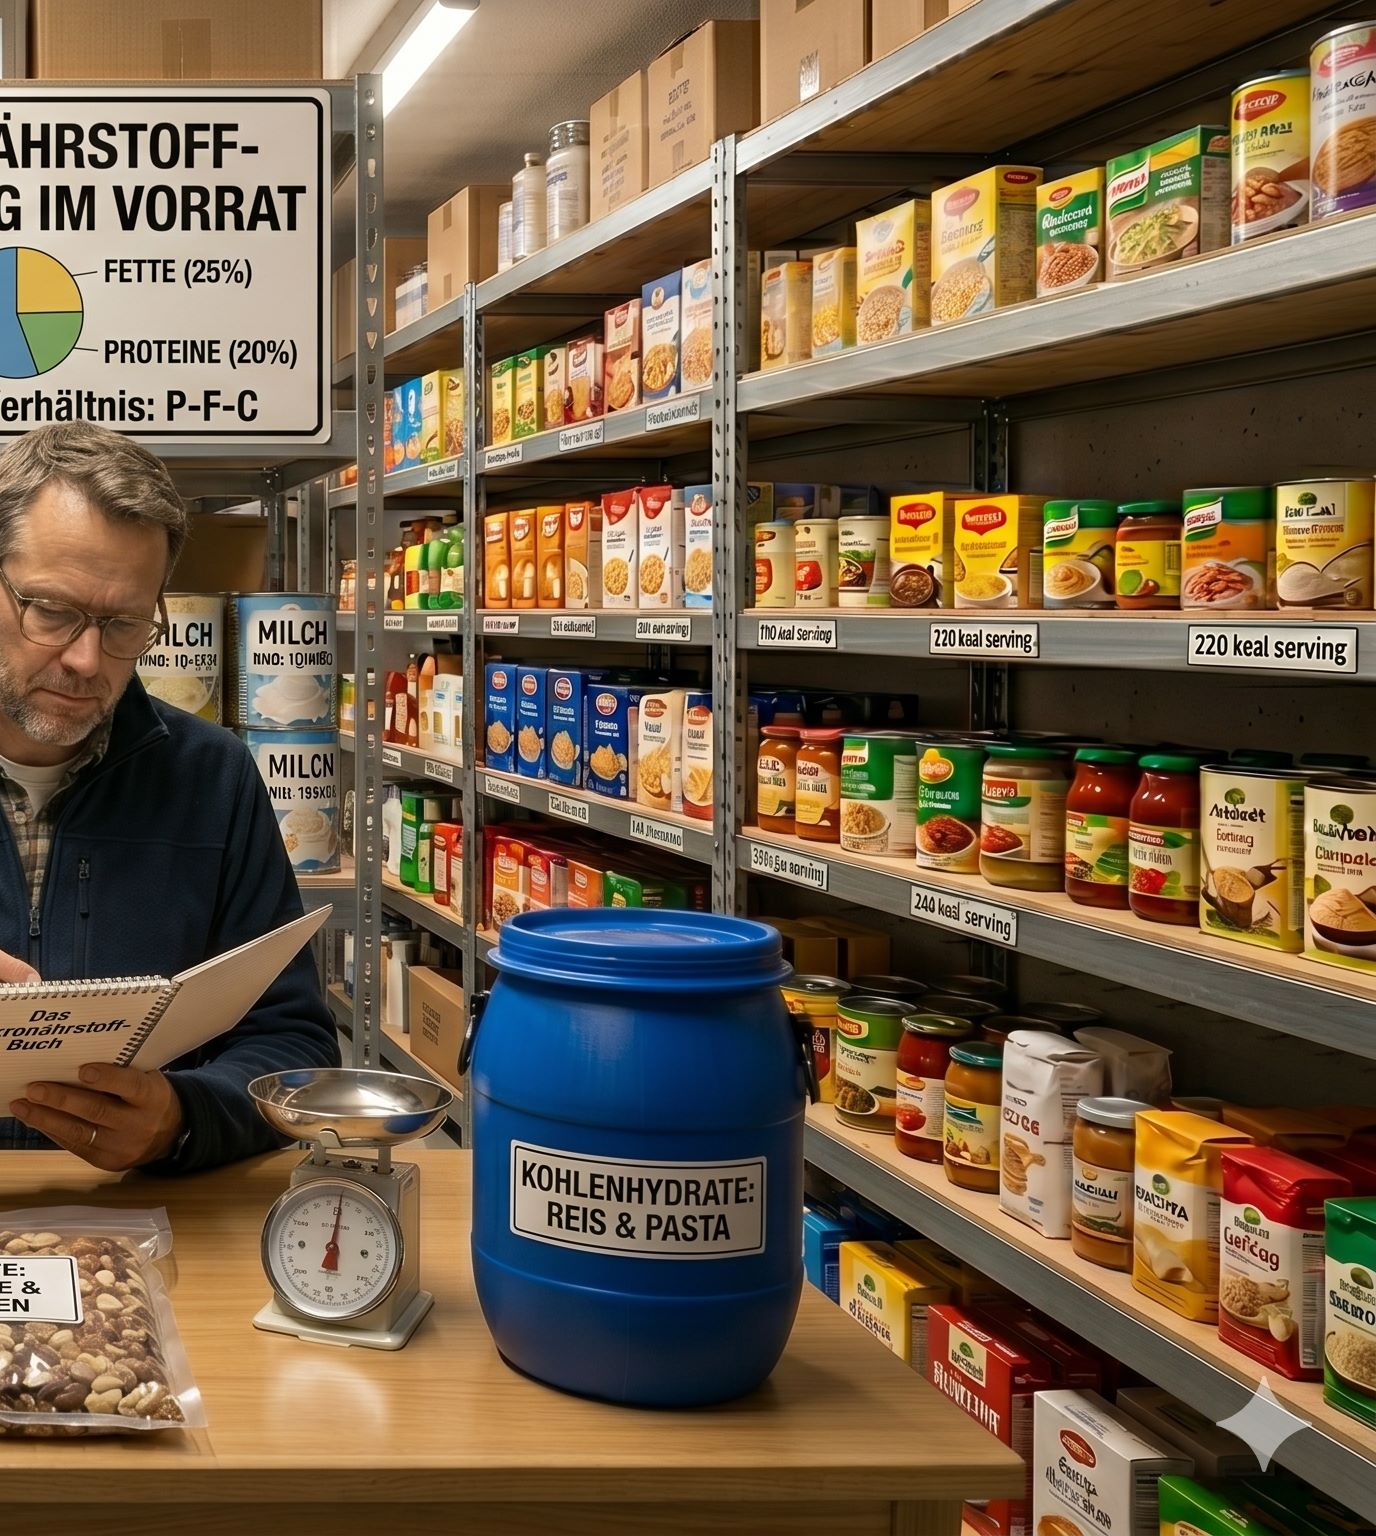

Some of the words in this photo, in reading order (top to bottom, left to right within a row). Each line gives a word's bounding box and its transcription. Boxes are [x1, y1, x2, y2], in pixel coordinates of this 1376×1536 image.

[39, 185, 96, 231] IM
[112, 184, 306, 232] VORRAT
[104, 259, 176, 283] FETTE
[183, 258, 253, 289] (25%)
[104, 339, 221, 364] PROTEINE
[228, 338, 298, 369] (20%)
[166, 389, 259, 422] P-F-C
[258, 620, 328, 646] MILCH
[934, 628, 956, 647] 220
[985, 629, 1033, 654] serving
[1194, 633, 1228, 656] 220
[1273, 635, 1348, 666] serving
[914, 892, 936, 914] 240
[964, 908, 1012, 942] serving
[29, 1009, 72, 1023] Das
[5, 1037, 64, 1052] Buch
[521, 1160, 755, 1205] KOHLENHYDRATE:
[546, 1200, 607, 1236] REIS
[614, 1211, 637, 1240] &
[645, 1213, 732, 1243] PASTA
[19, 1279, 42, 1295] &
